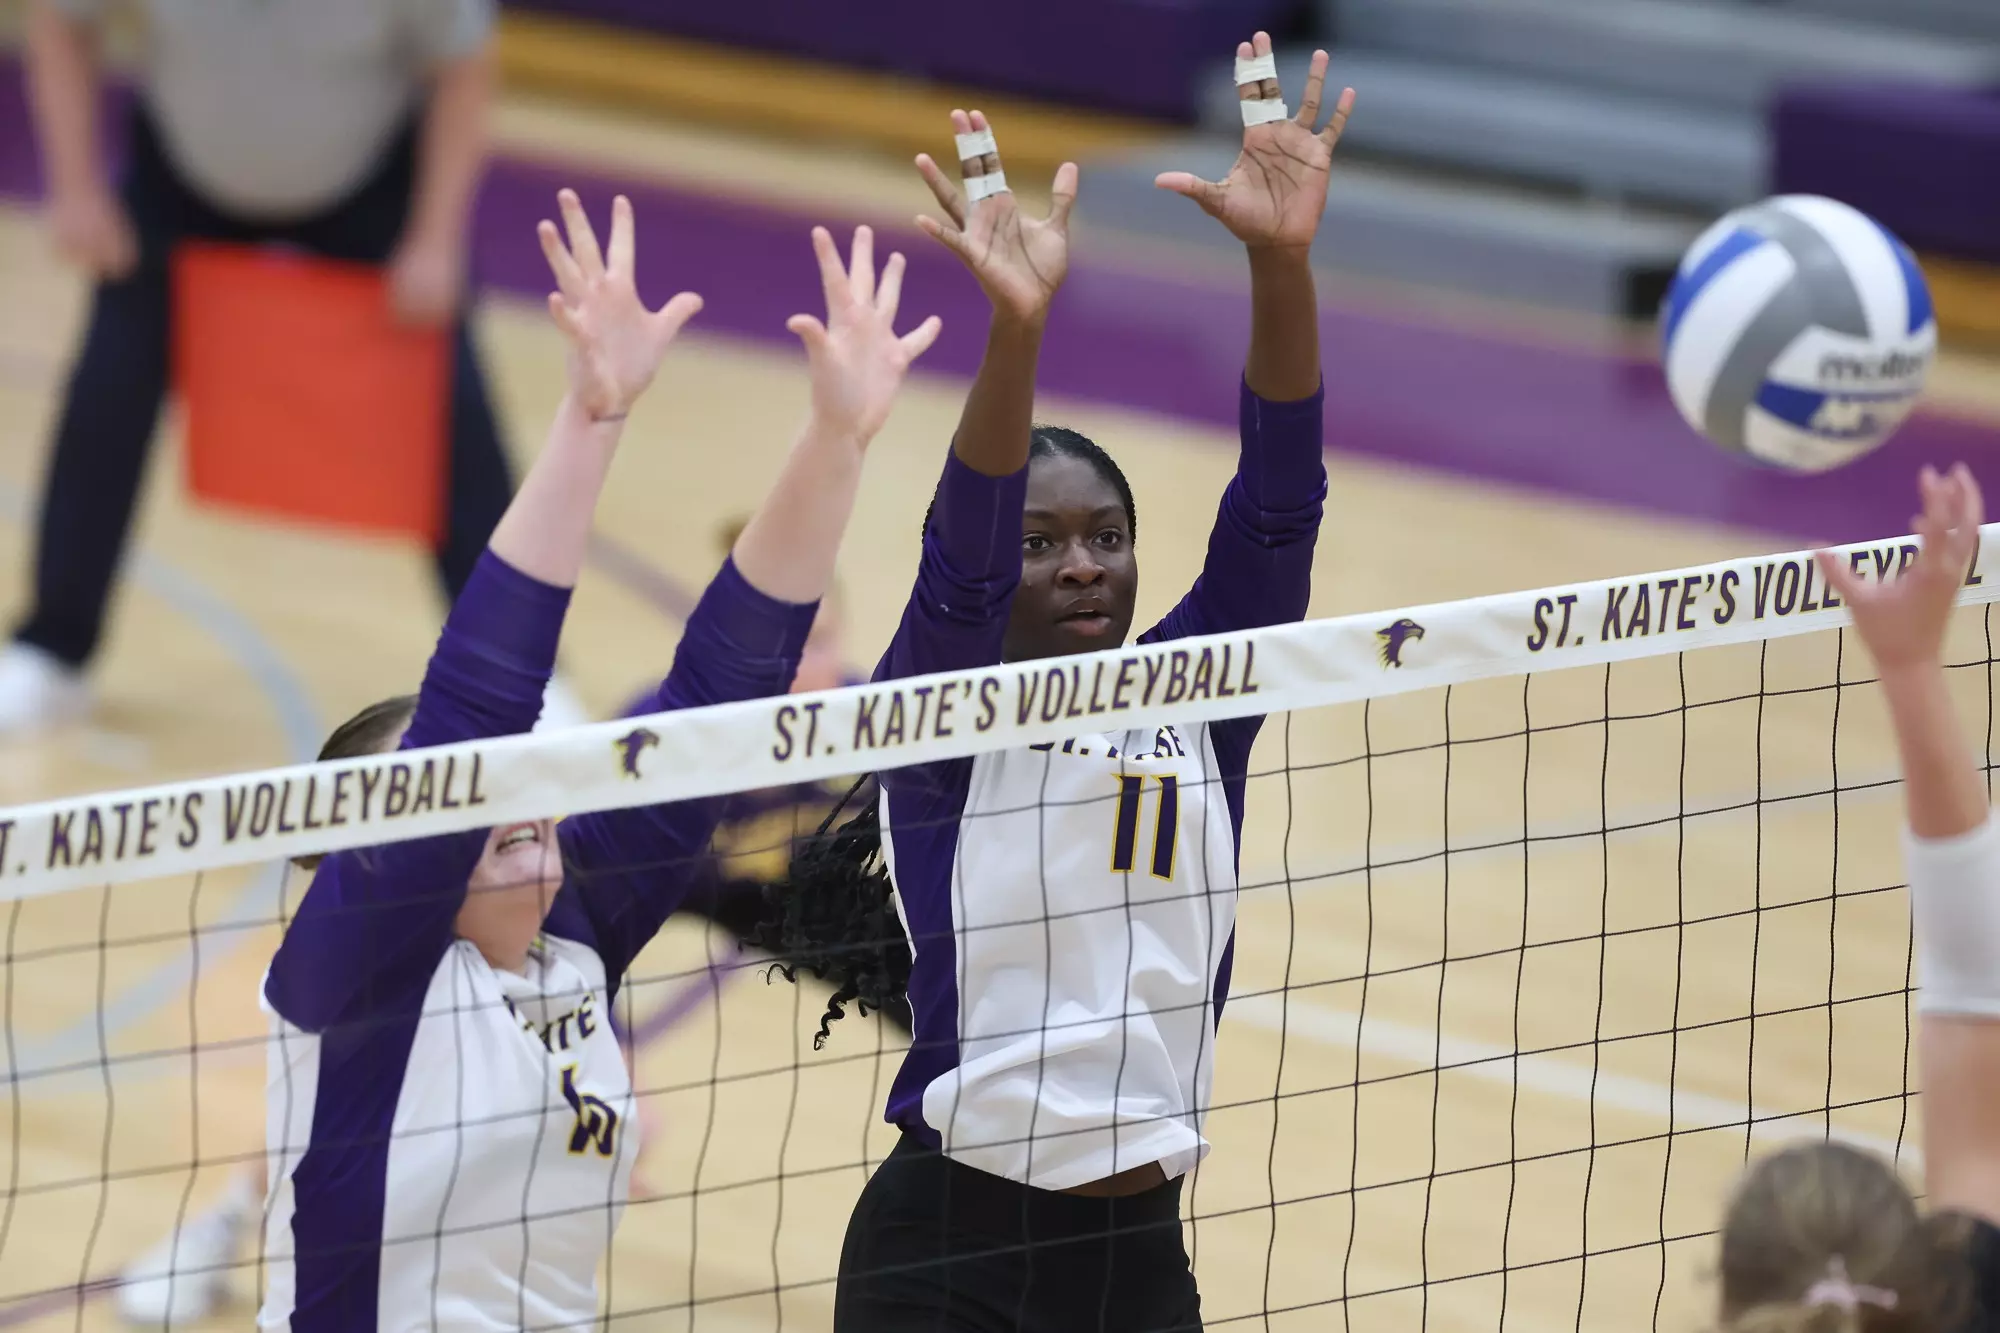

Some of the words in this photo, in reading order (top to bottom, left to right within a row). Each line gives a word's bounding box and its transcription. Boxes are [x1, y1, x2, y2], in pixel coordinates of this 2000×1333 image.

[1527, 594, 1584, 652] ST.
[1601, 569, 1740, 642] KATE'S
[1753, 533, 1983, 621] VOLLEYL
[773, 702, 836, 762] ST.
[853, 676, 1001, 751] KATE'S
[1016, 640, 1260, 726] VOLLEYBALL
[46, 792, 204, 870] KATE'S
[223, 752, 487, 843] VOLLEYBALL
[1110, 772, 1181, 882] 11
